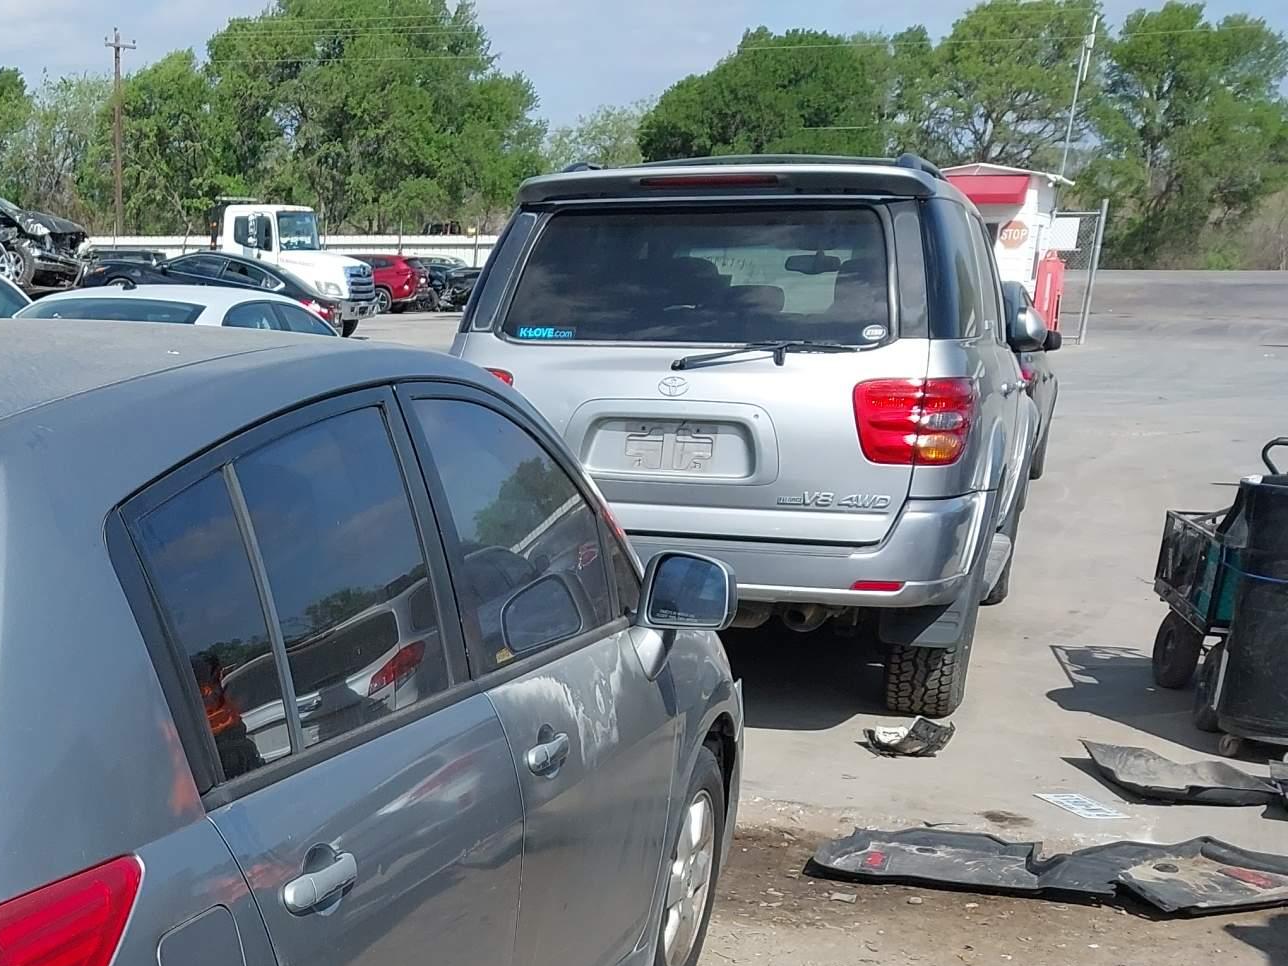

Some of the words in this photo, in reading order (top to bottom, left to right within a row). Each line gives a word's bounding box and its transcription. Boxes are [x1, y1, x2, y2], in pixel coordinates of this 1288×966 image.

[1000, 229, 1028, 240] STOP
[803, 490, 834, 507] V8
[837, 494, 891, 509] 4WD
